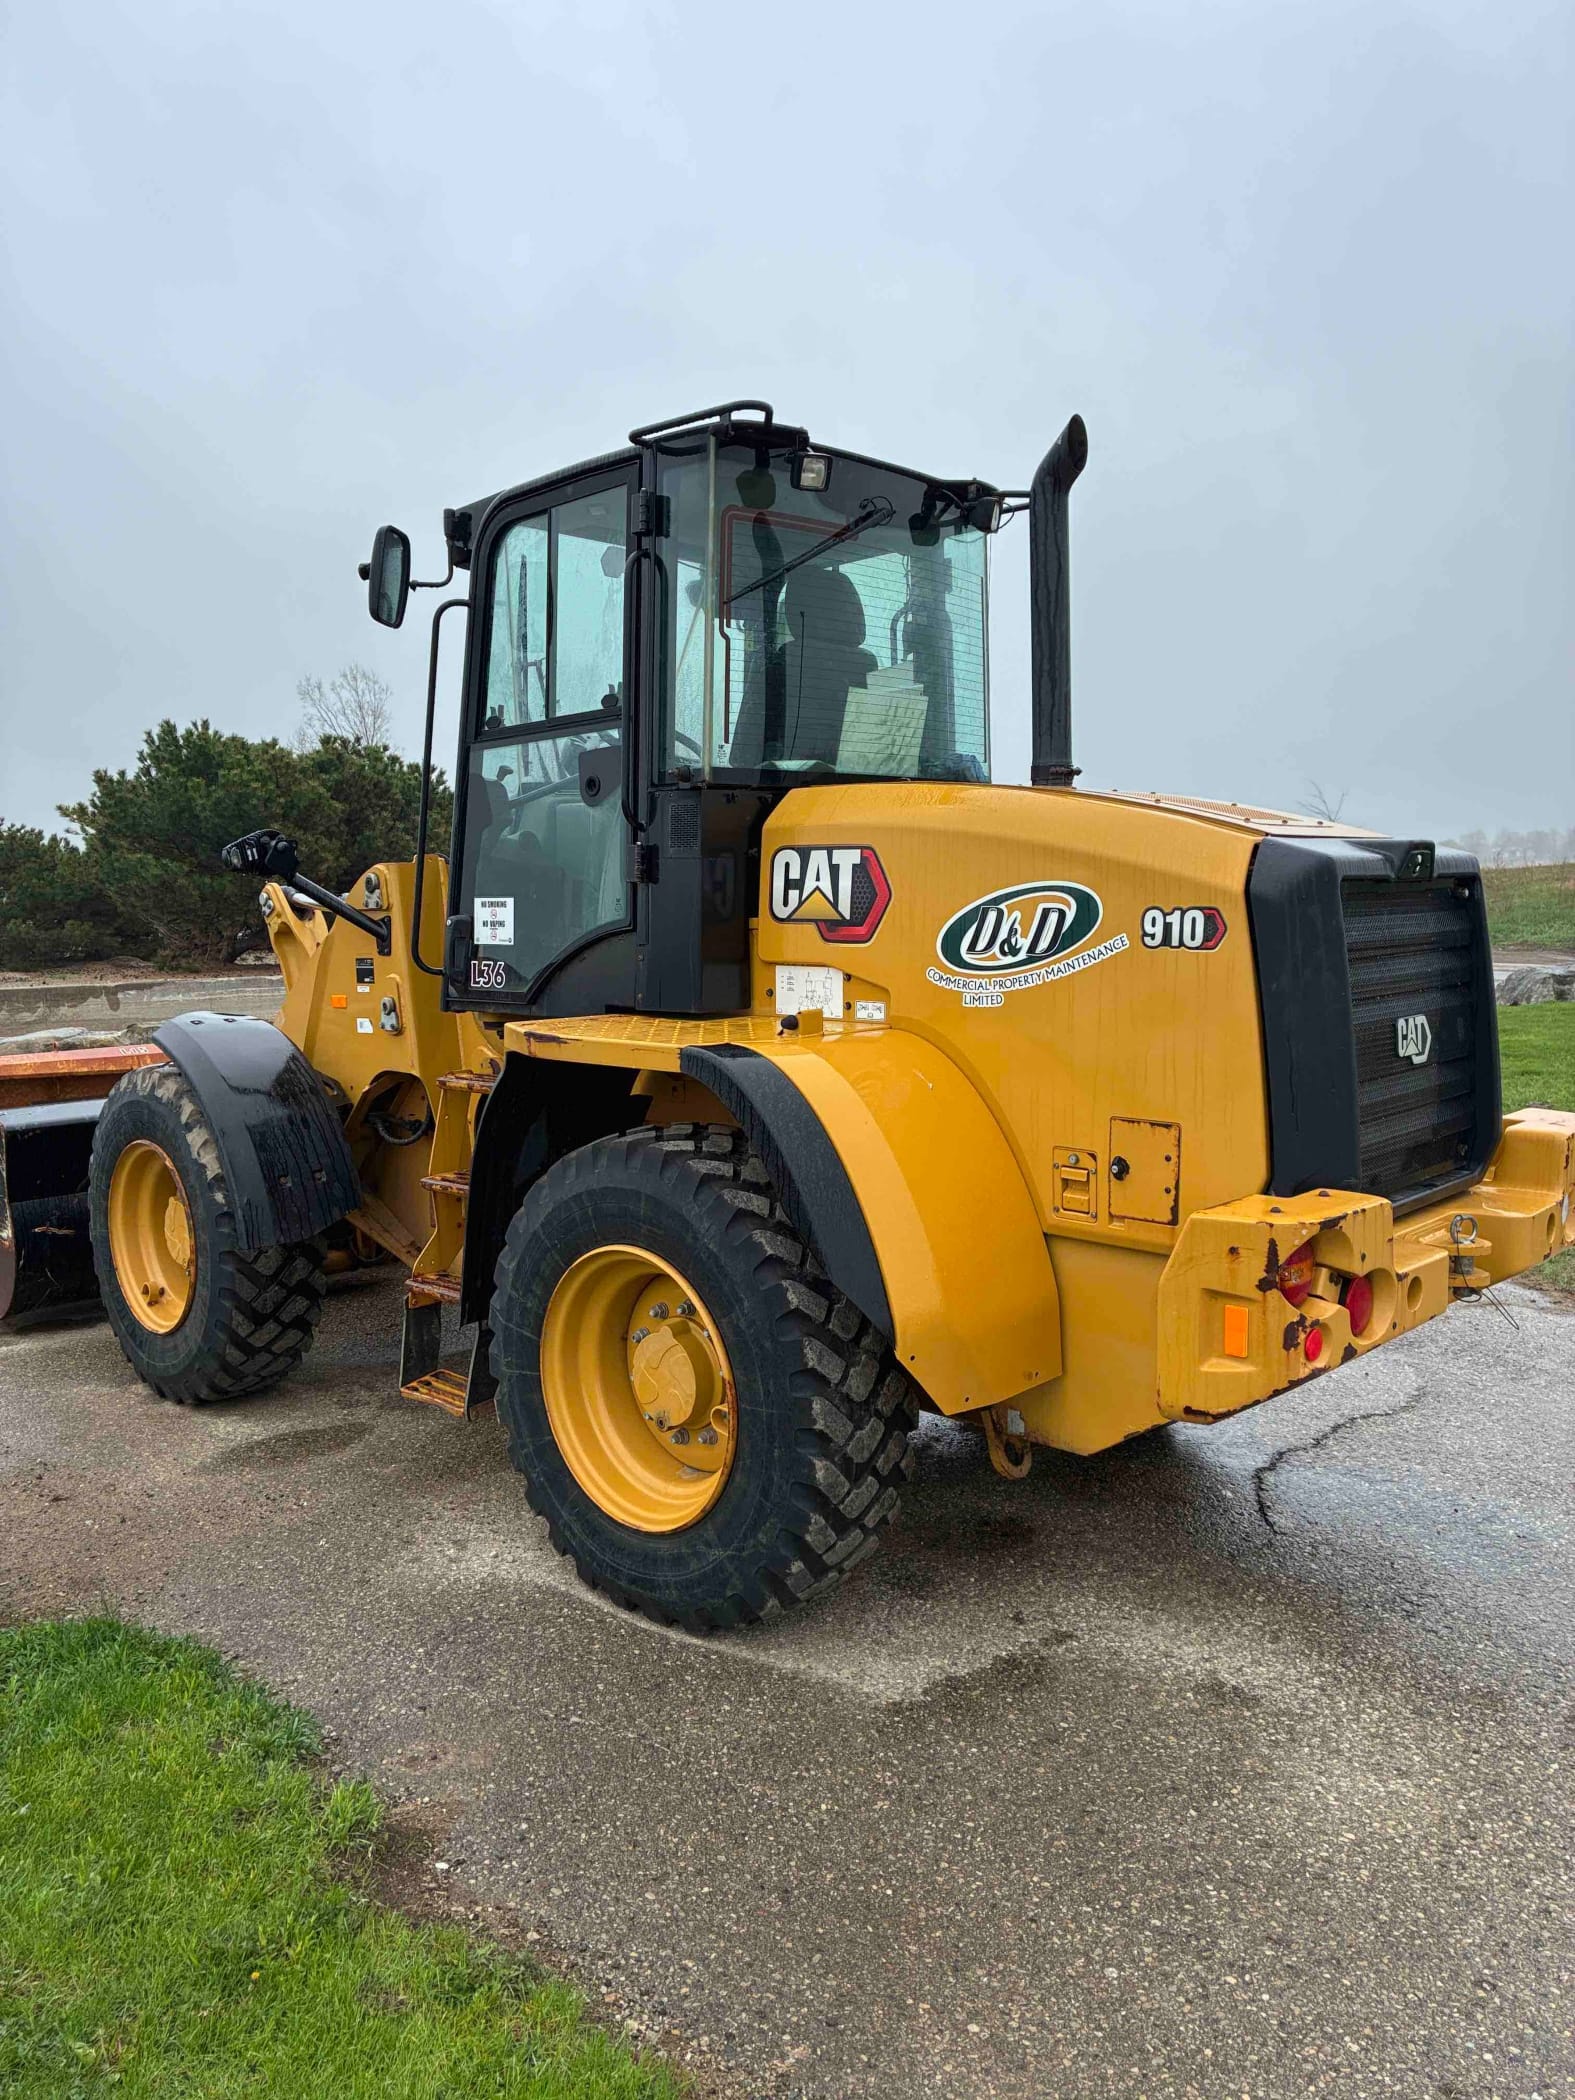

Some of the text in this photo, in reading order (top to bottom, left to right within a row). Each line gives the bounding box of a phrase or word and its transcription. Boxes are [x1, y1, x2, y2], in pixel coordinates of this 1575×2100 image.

[772, 848, 861, 920] CAT
[965, 905, 1067, 957] D&D
[1143, 908, 1205, 949] 910
[470, 961, 506, 988] L36
[927, 938, 1128, 991] COMMERCIAL PROPERTY MAINTENANCE
[964, 994, 1003, 1006] LIMITED
[1397, 1014, 1425, 1058] CAT
